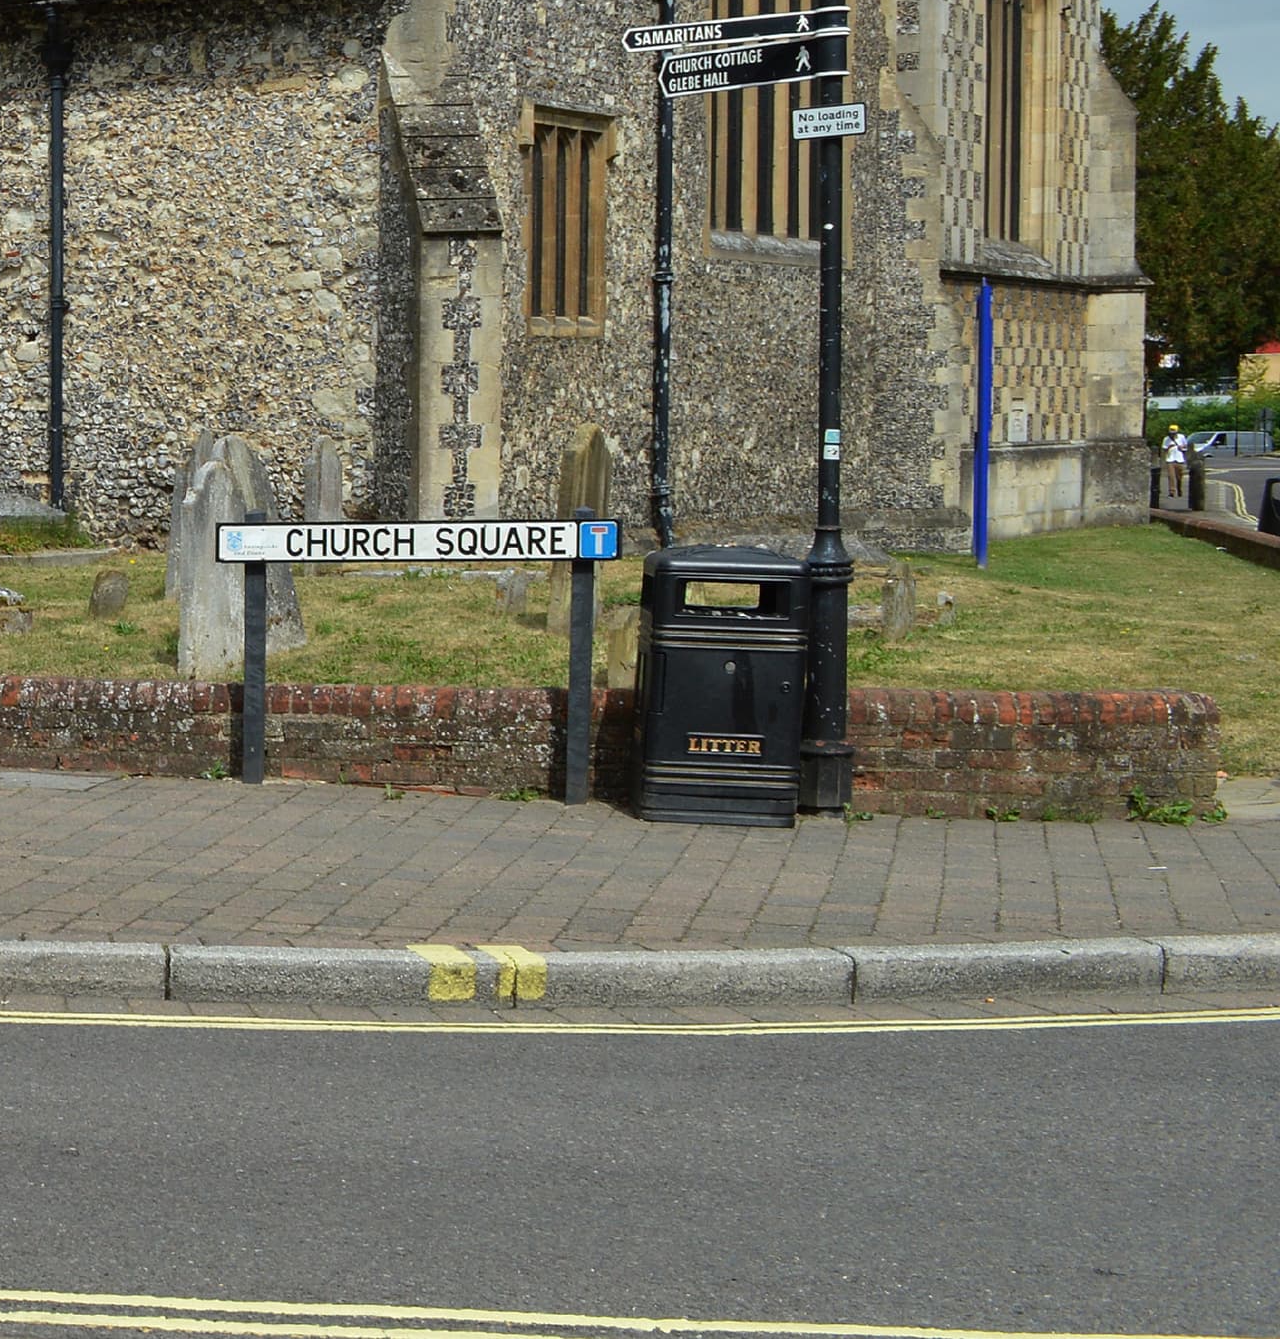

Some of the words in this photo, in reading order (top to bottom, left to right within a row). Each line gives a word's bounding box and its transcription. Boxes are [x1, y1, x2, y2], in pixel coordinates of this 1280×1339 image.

[634, 25, 722, 46] SAMARITANS
[668, 56, 712, 74] CHURCH
[714, 49, 763, 68] COTTAGE
[668, 76, 701, 92] GLEBE
[703, 72, 729, 87] HALL
[799, 113, 814, 122] No
[818, 110, 858, 121] loading
[798, 125, 809, 134] at
[813, 124, 832, 133] any
[836, 121, 860, 130] time
[287, 527, 415, 557] CHURCH
[436, 526, 567, 556] SQUARE
[688, 738, 761, 753] LITTER
